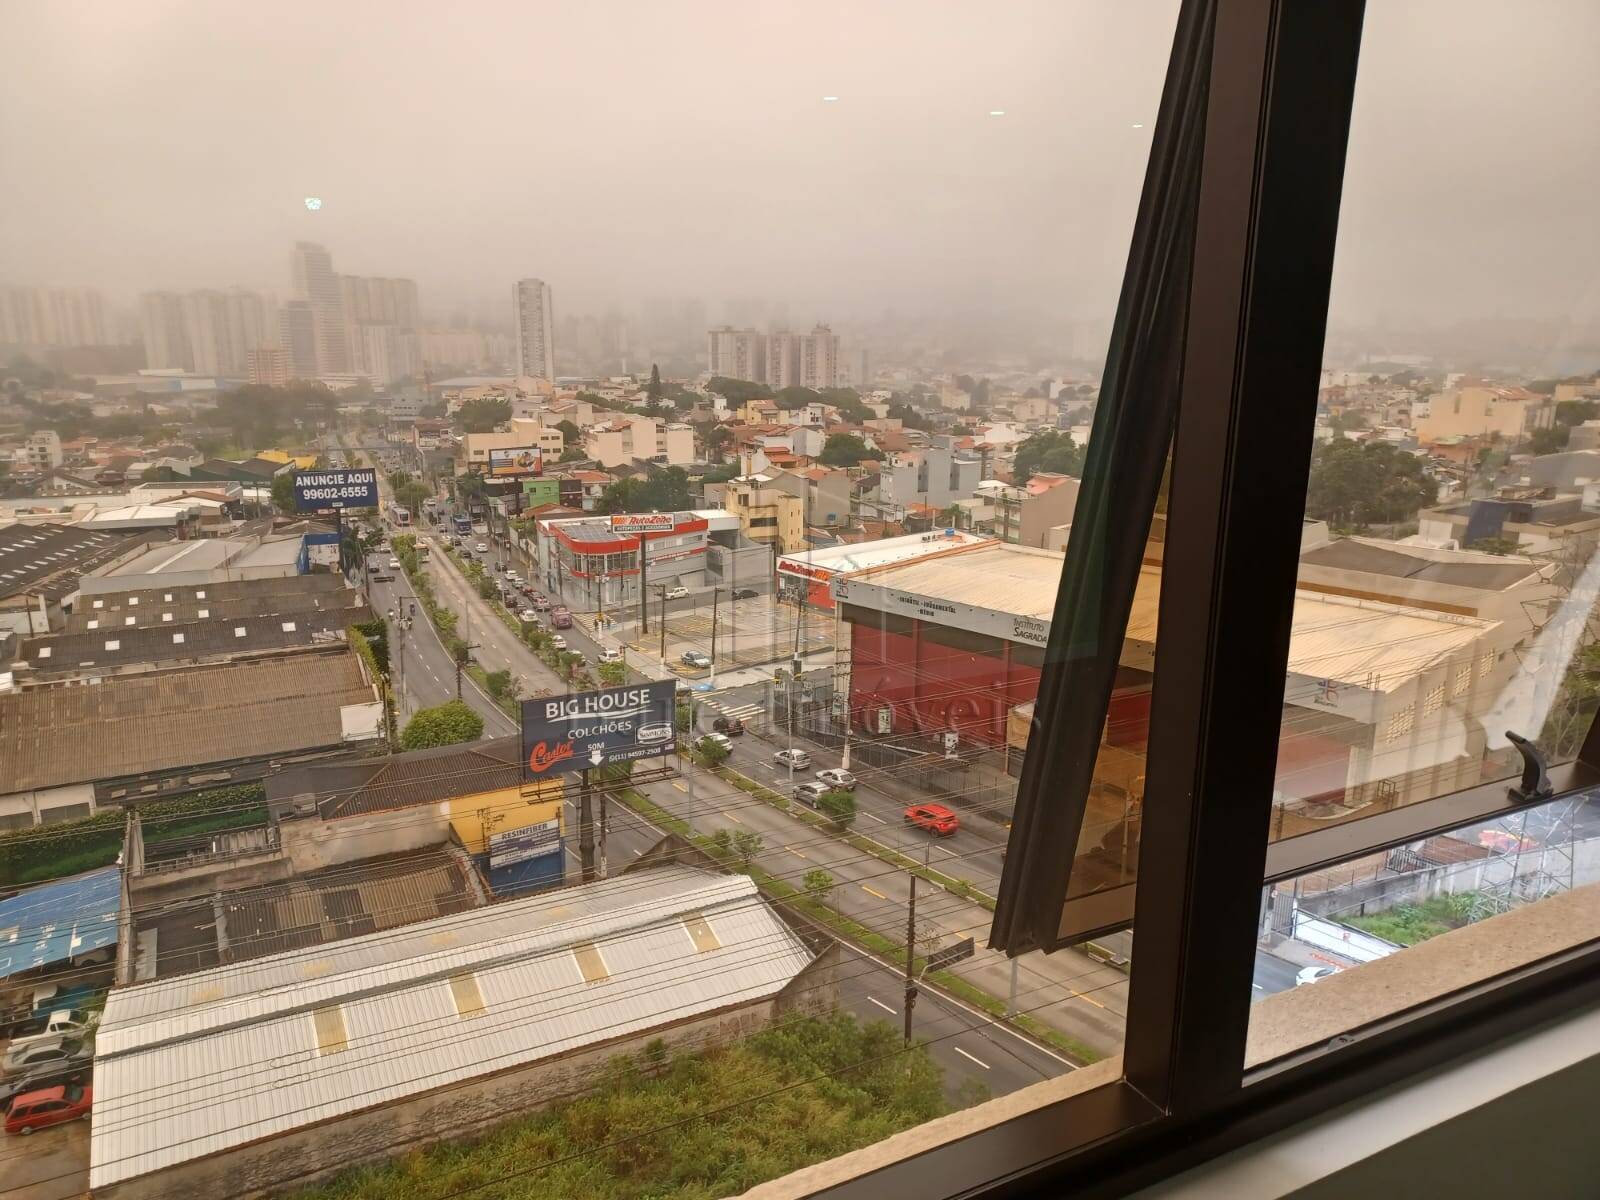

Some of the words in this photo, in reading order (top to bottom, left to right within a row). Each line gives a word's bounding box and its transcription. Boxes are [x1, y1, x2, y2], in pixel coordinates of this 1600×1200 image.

[295, 474, 345, 487] ANUNCIE
[347, 472, 373, 484] AQUI
[303, 486, 368, 500] 99602-6555
[629, 515, 672, 525] AutoZone
[1013, 617, 1044, 632] INSTITUTO
[545, 699, 579, 719] BIG
[585, 689, 651, 712] HOUSE
[567, 720, 632, 740] COLCHÕES
[502, 823, 548, 840] RESINFIBER
